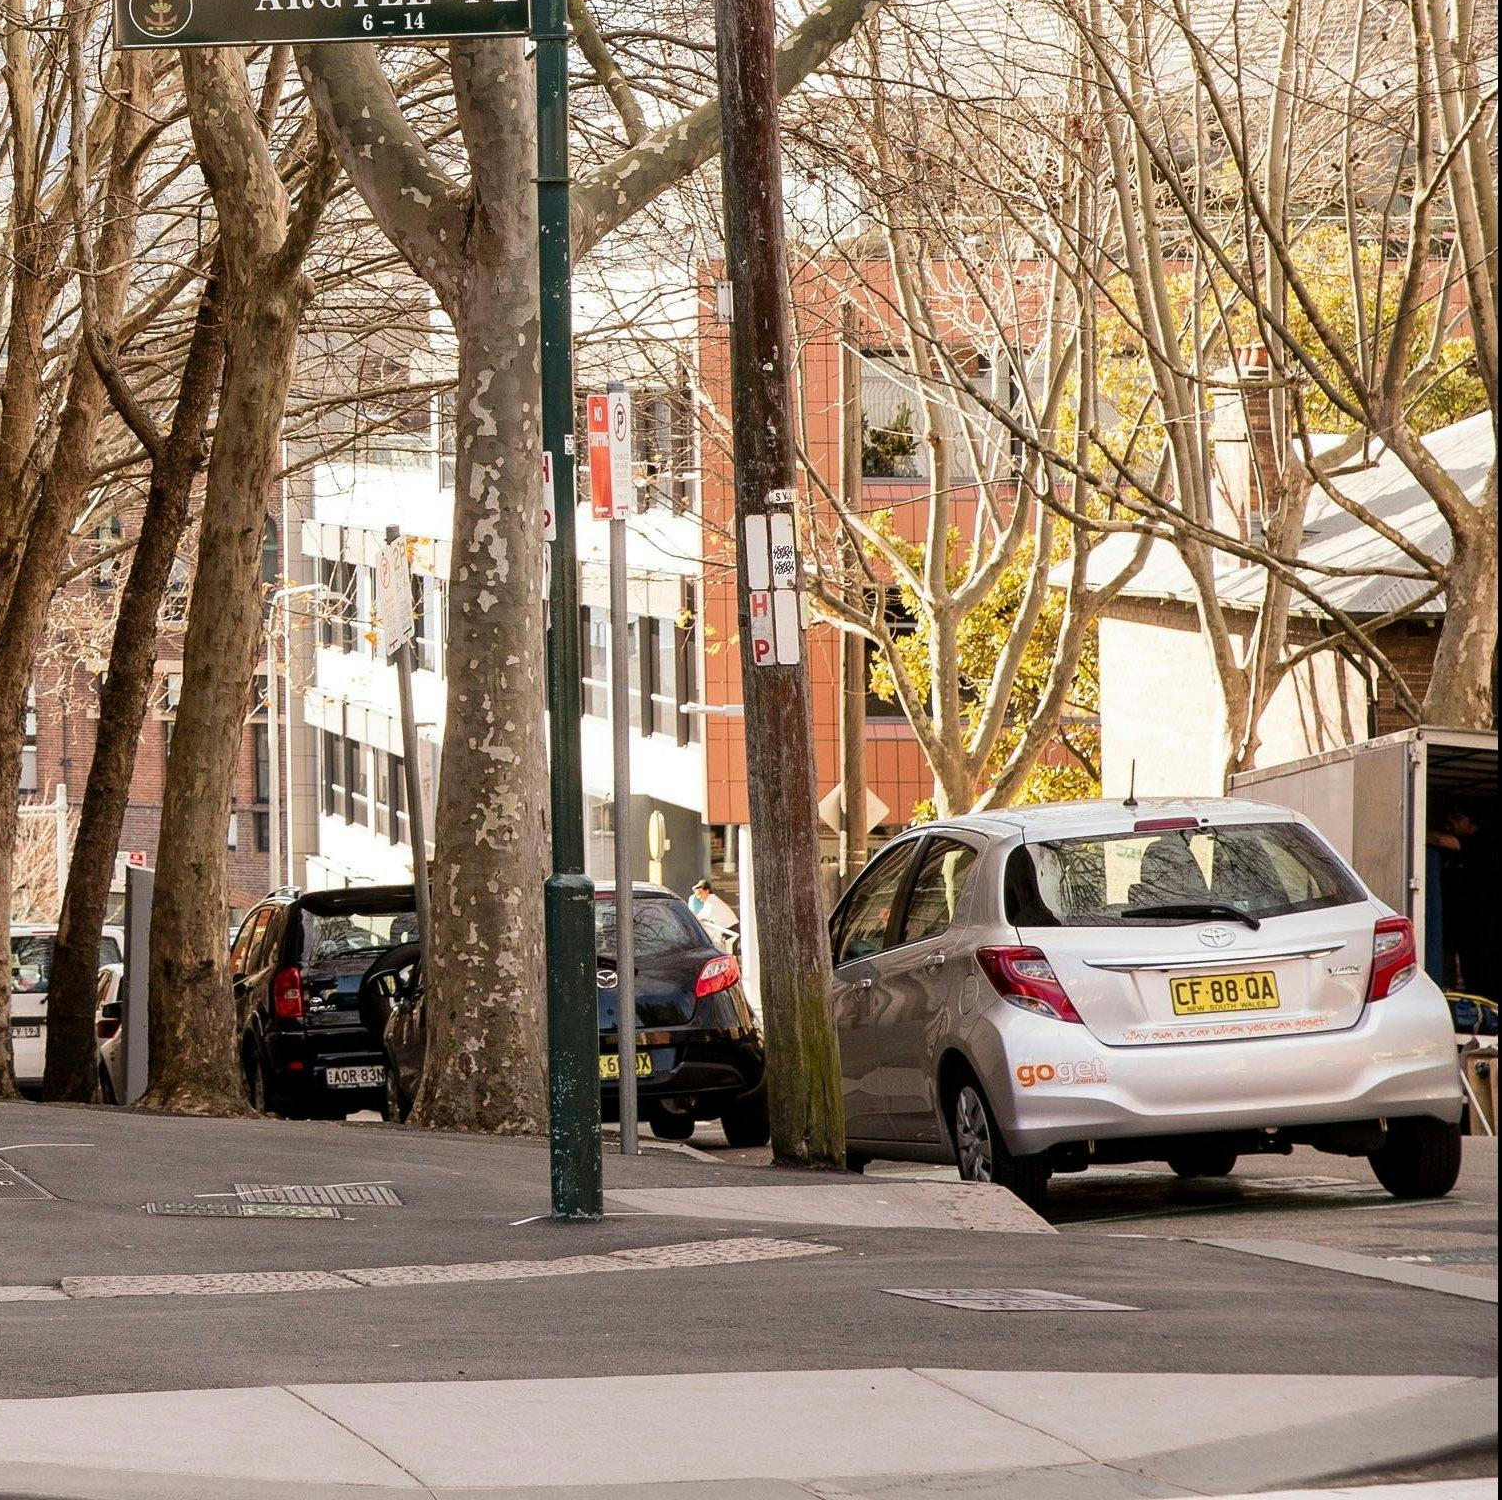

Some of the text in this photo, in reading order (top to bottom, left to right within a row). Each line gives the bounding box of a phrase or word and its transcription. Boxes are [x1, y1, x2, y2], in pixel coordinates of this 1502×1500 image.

[362, 14, 374, 31] 6
[404, 11, 425, 31] 14
[1187, 1005, 1205, 1013] NEW
[1209, 1003, 1237, 1011] SOUTH
[1151, 1031, 1173, 1040] own
[1176, 1029, 1186, 1038] a
[1189, 1028, 1209, 1037] car
[1213, 1025, 1245, 1036] when
[1247, 1023, 1268, 1037] you
[1270, 1021, 1291, 1031] can
[1016, 1056, 1107, 1088] goget
